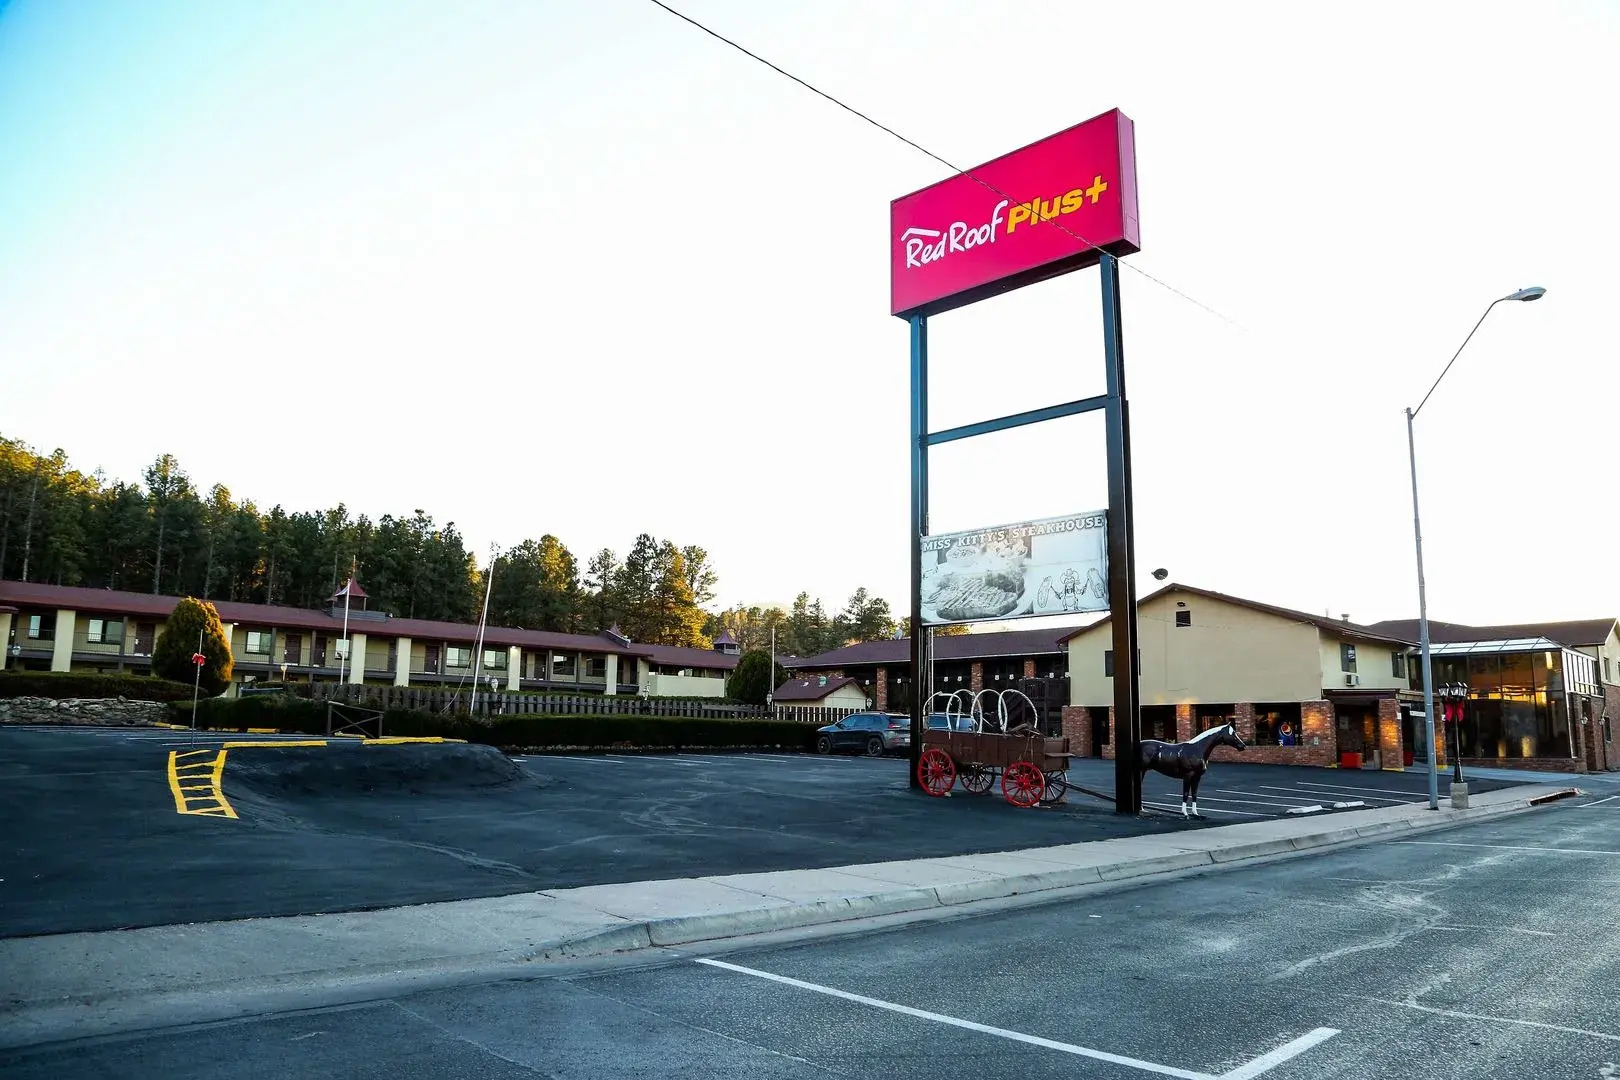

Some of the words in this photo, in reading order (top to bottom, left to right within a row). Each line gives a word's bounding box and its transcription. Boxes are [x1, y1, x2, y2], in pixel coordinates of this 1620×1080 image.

[922, 540, 951, 552] MISS
[957, 531, 1006, 547] KITTY'S
[1012, 517, 1103, 538] STEAKHOUSE
